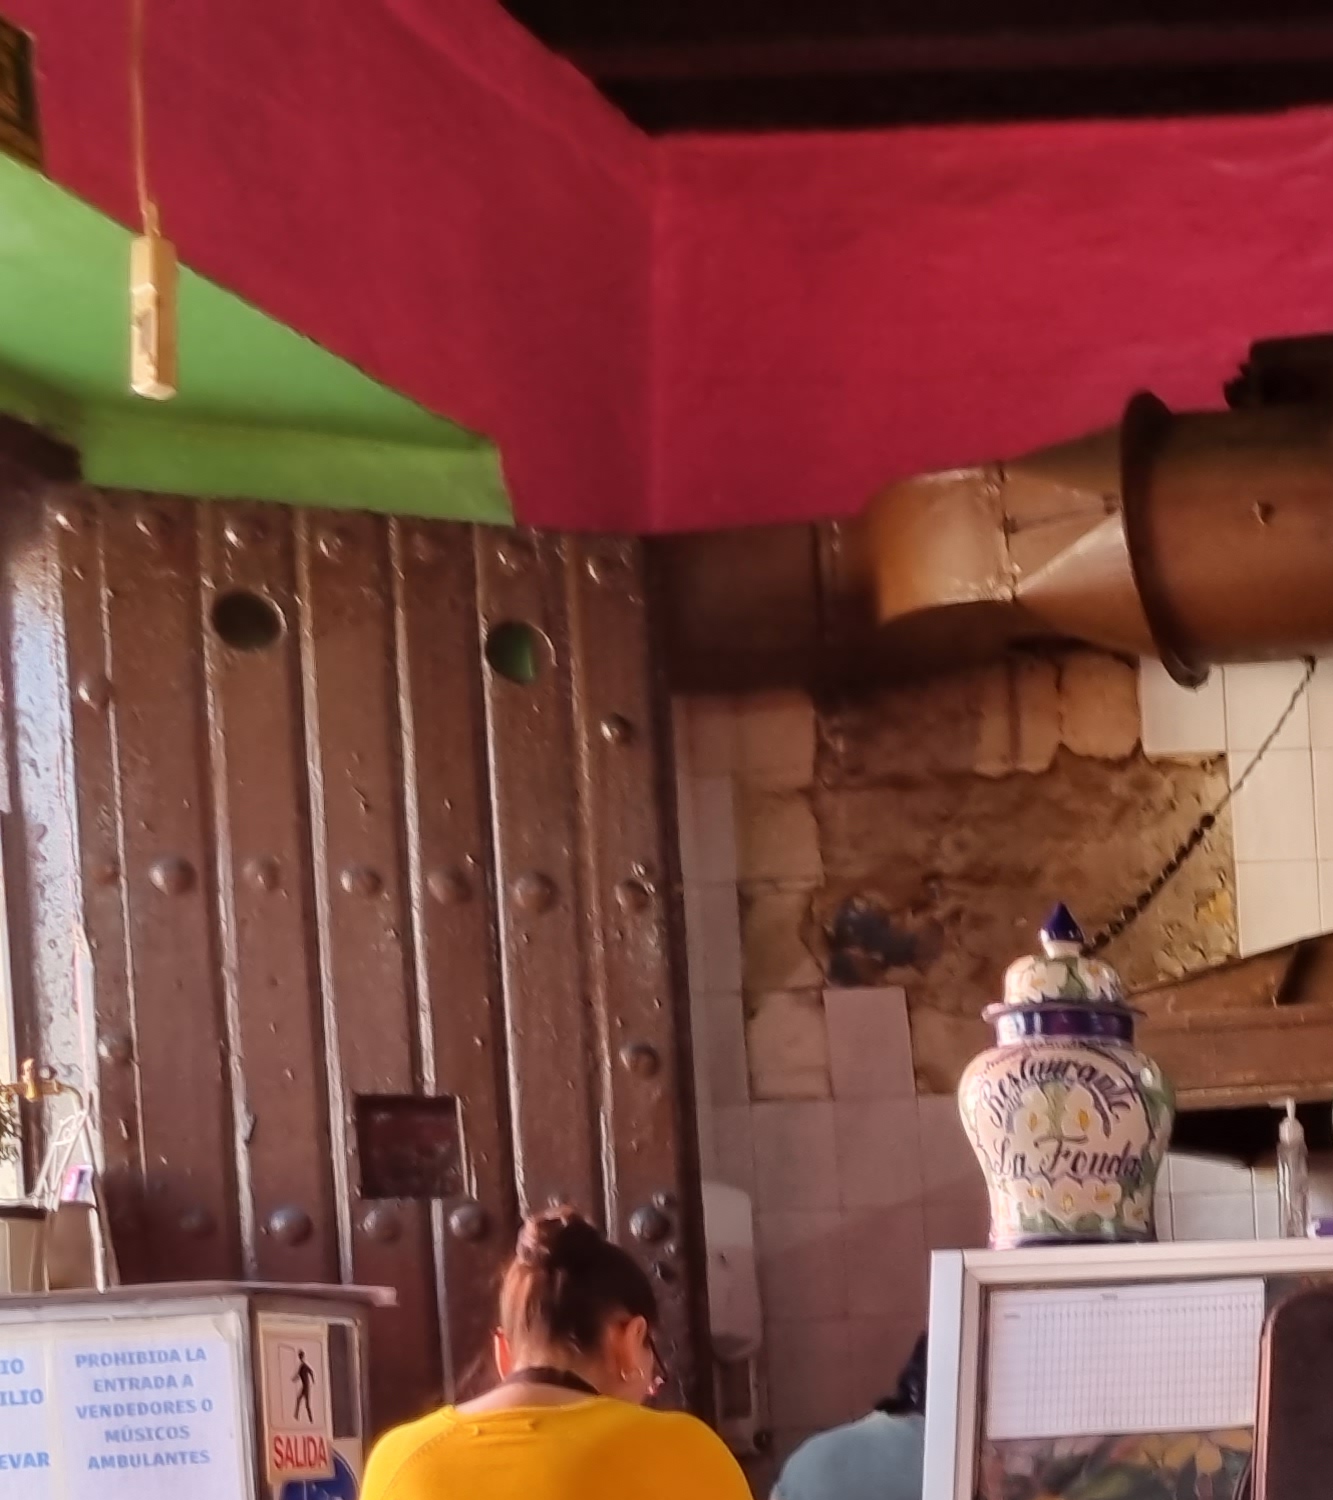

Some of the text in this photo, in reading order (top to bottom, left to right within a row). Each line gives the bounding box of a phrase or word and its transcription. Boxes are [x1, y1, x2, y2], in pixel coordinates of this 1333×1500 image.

[75, 1348, 207, 1368] PROHIBIDA LA
[94, 1374, 194, 1393] ENTRADA A
[76, 1398, 213, 1419] VENDEDORES O
[105, 1425, 190, 1443] MÚSICOS
[88, 1450, 210, 1470] AMBULANTES
[274, 1436, 328, 1470] SALIDA
